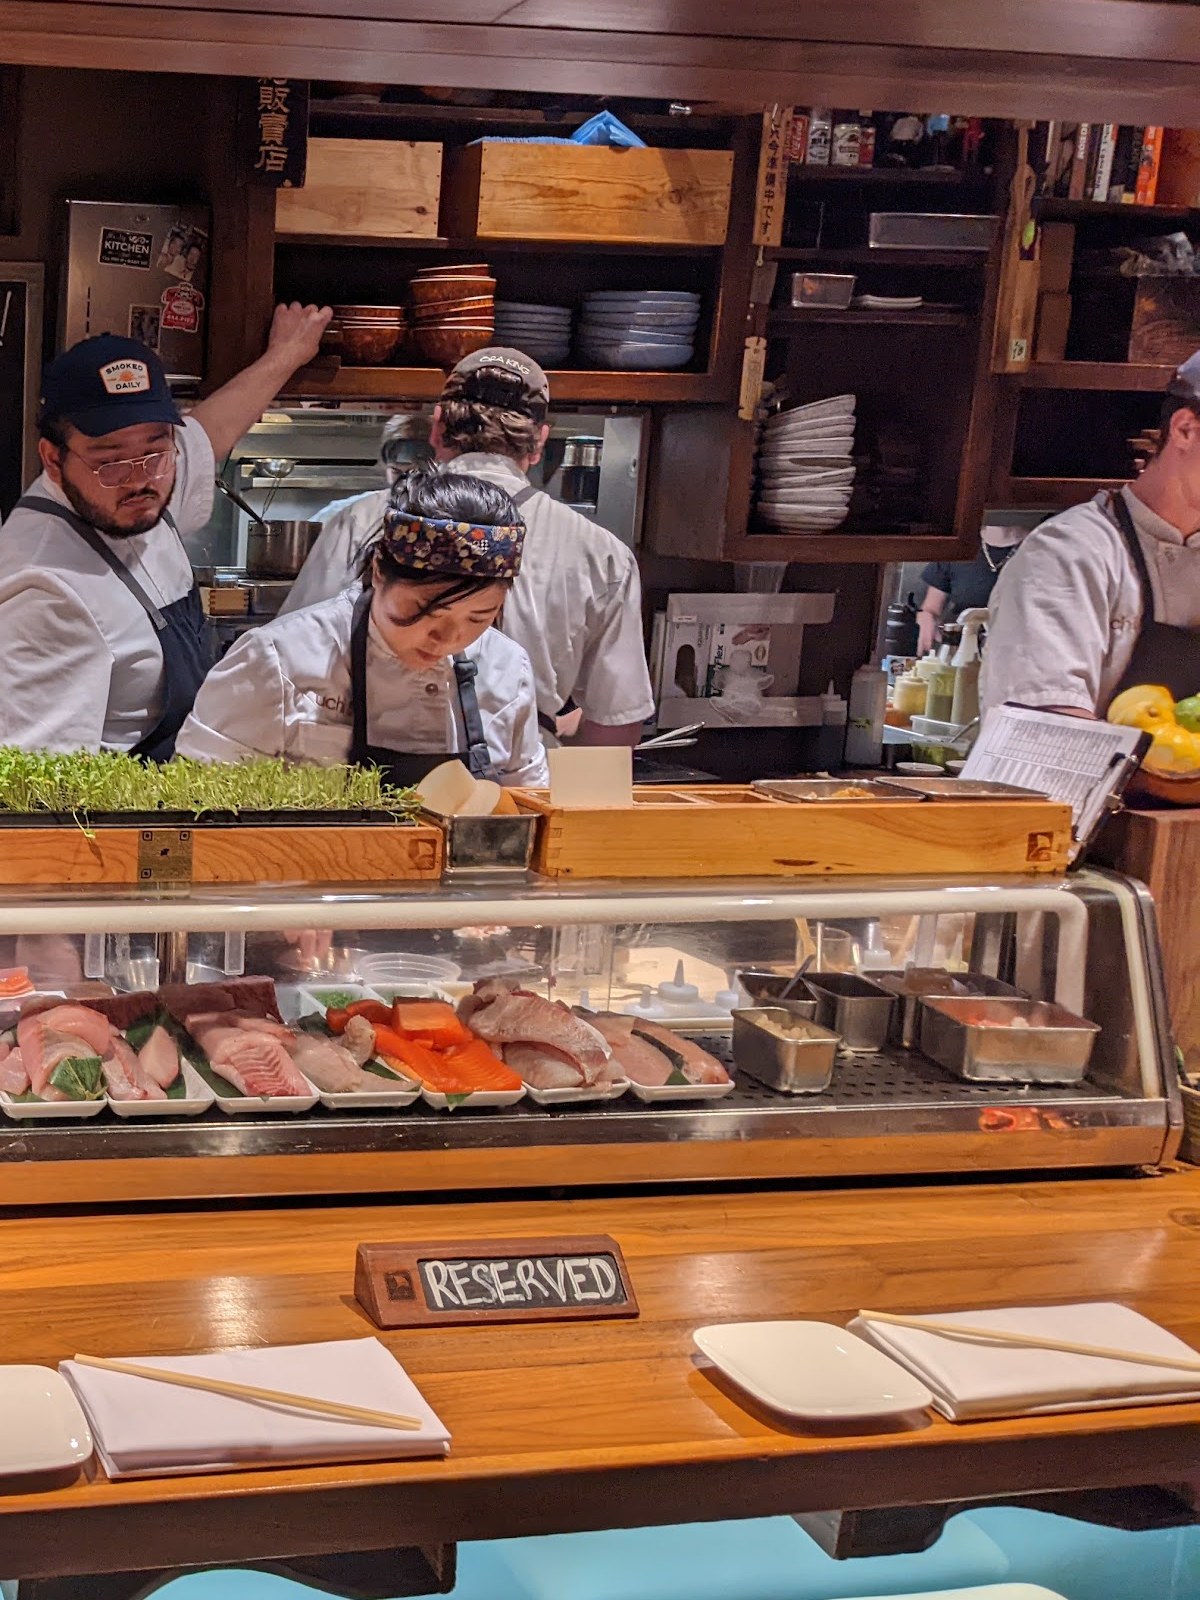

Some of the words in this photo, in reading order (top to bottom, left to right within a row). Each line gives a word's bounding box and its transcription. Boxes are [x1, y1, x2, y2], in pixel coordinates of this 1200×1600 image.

[254, 78, 291, 172] 販賣店
[104, 240, 150, 255] KITCHEN
[105, 363, 143, 374] SMOKED
[506, 359, 530, 374] KING
[115, 381, 141, 390] DAILY
[425, 1258, 616, 1307] RESERVED
